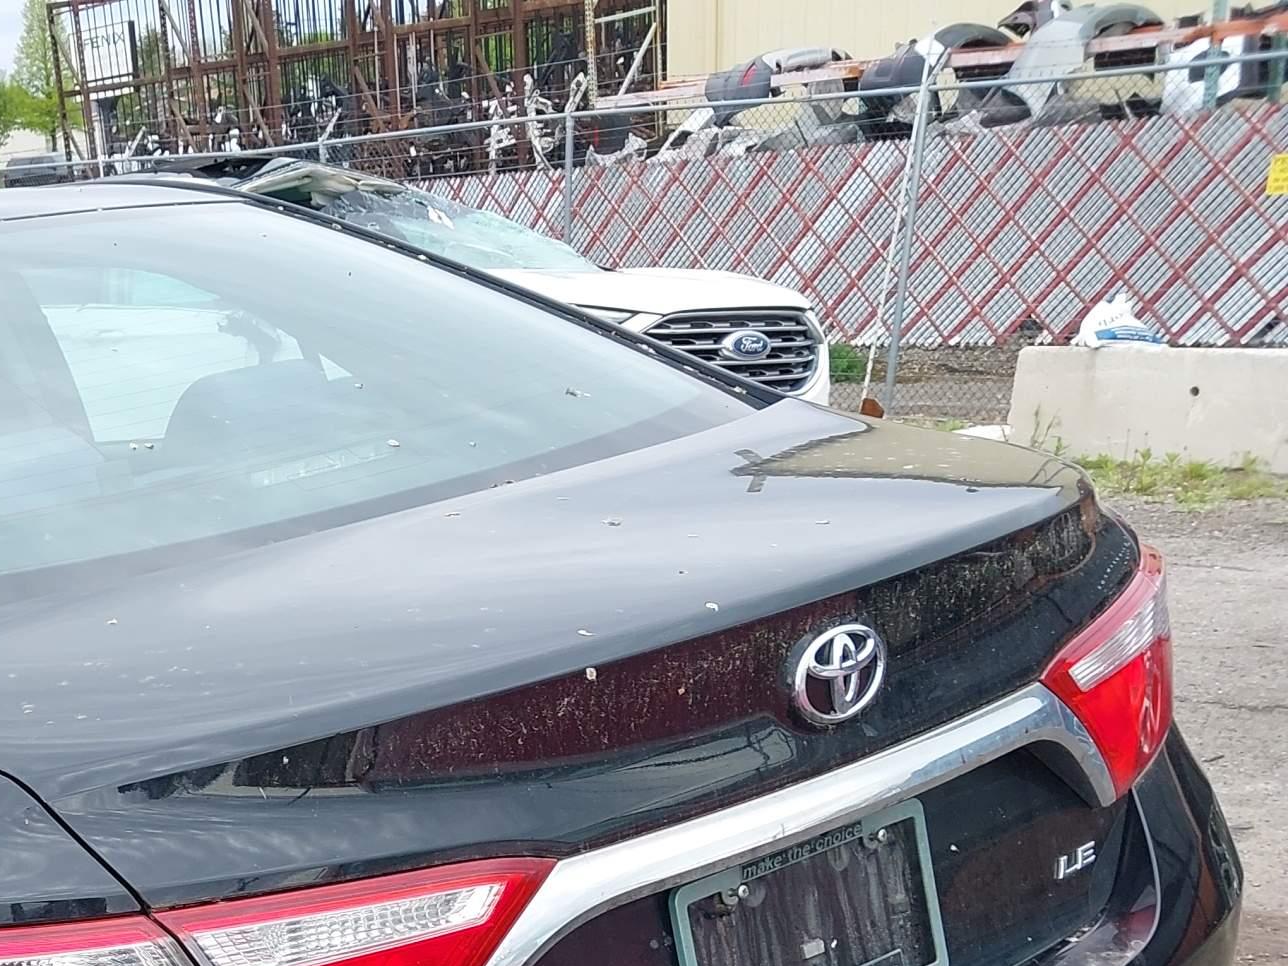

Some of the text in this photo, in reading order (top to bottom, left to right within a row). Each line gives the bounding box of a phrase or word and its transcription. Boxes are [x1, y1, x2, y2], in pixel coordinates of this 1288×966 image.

[740, 336, 764, 352] Ford
[743, 853, 782, 879] make
[787, 845, 811, 863] the
[1054, 840, 1096, 879] LE
